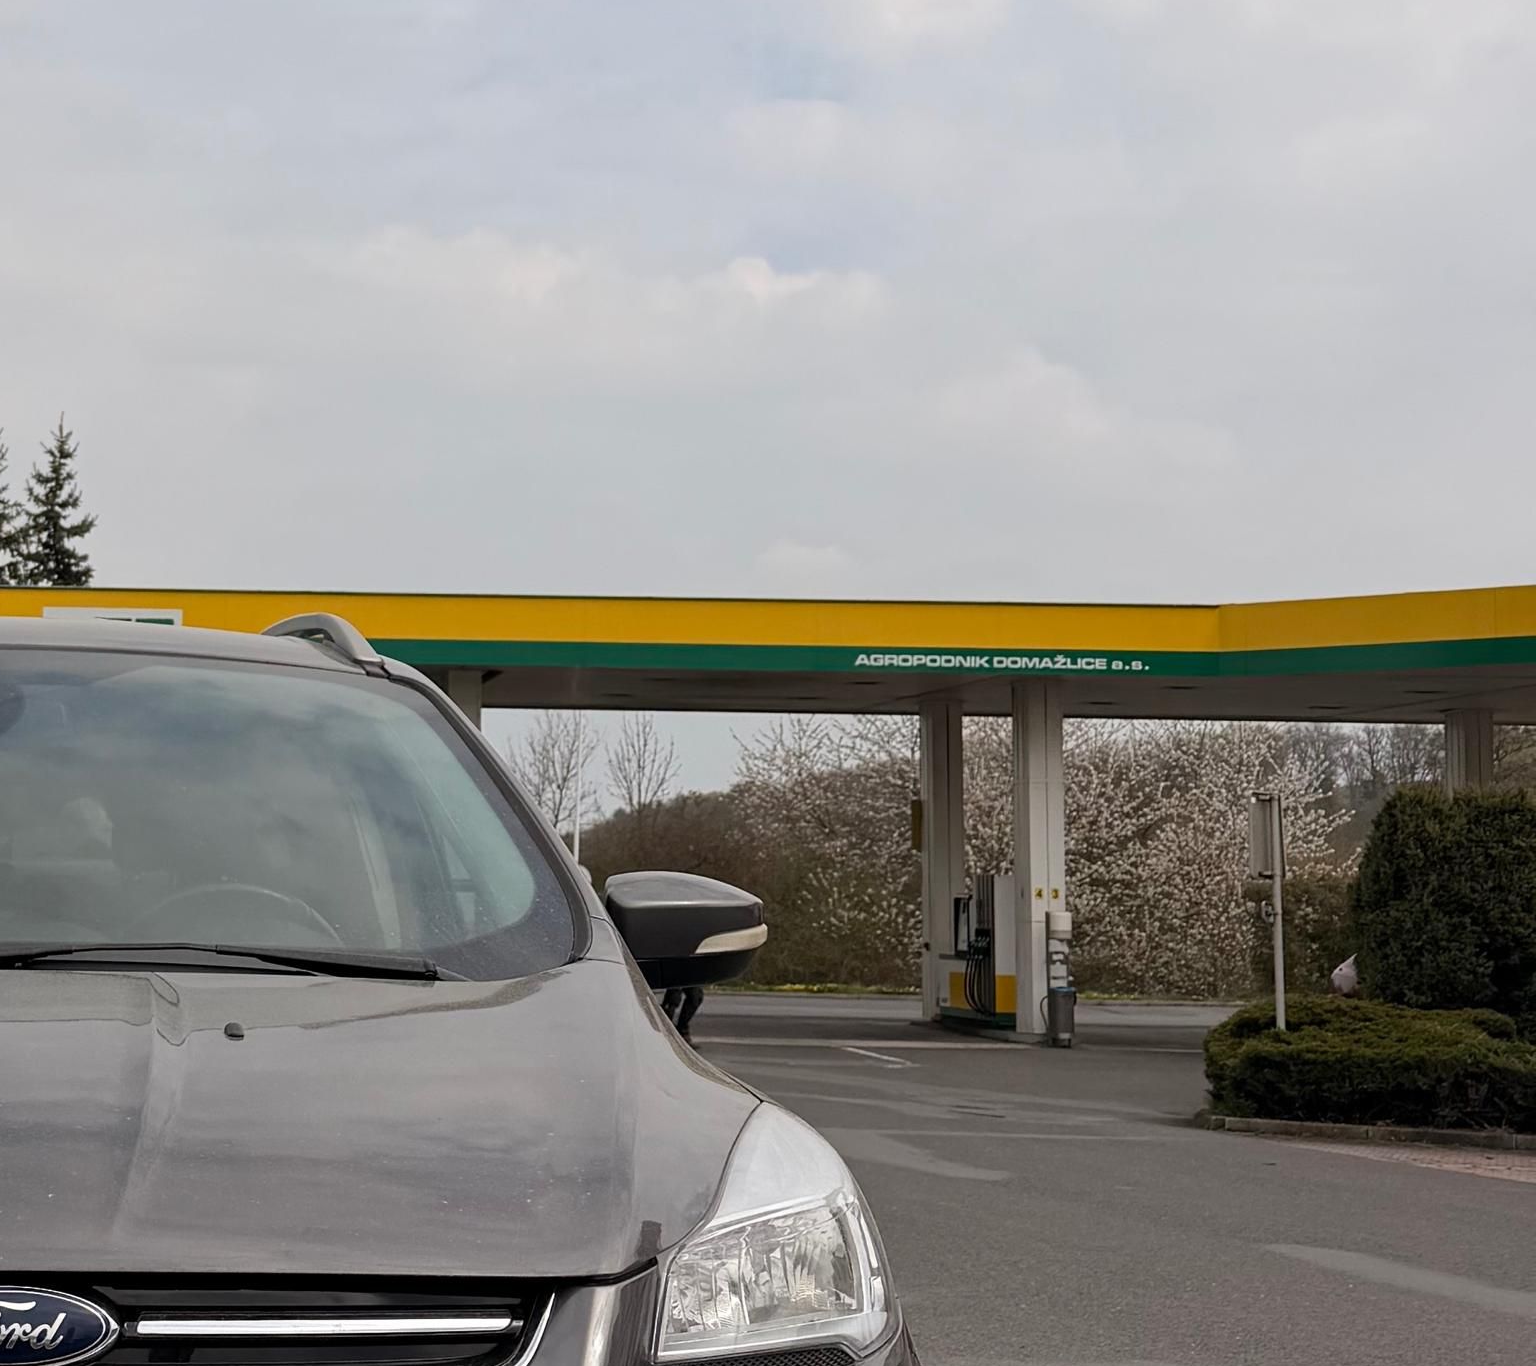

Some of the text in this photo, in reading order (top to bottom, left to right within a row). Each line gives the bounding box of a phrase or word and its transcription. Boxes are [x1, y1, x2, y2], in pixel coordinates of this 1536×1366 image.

[854, 653, 1150, 671] AGROPODNIK DOMAŽLICE a.s.
